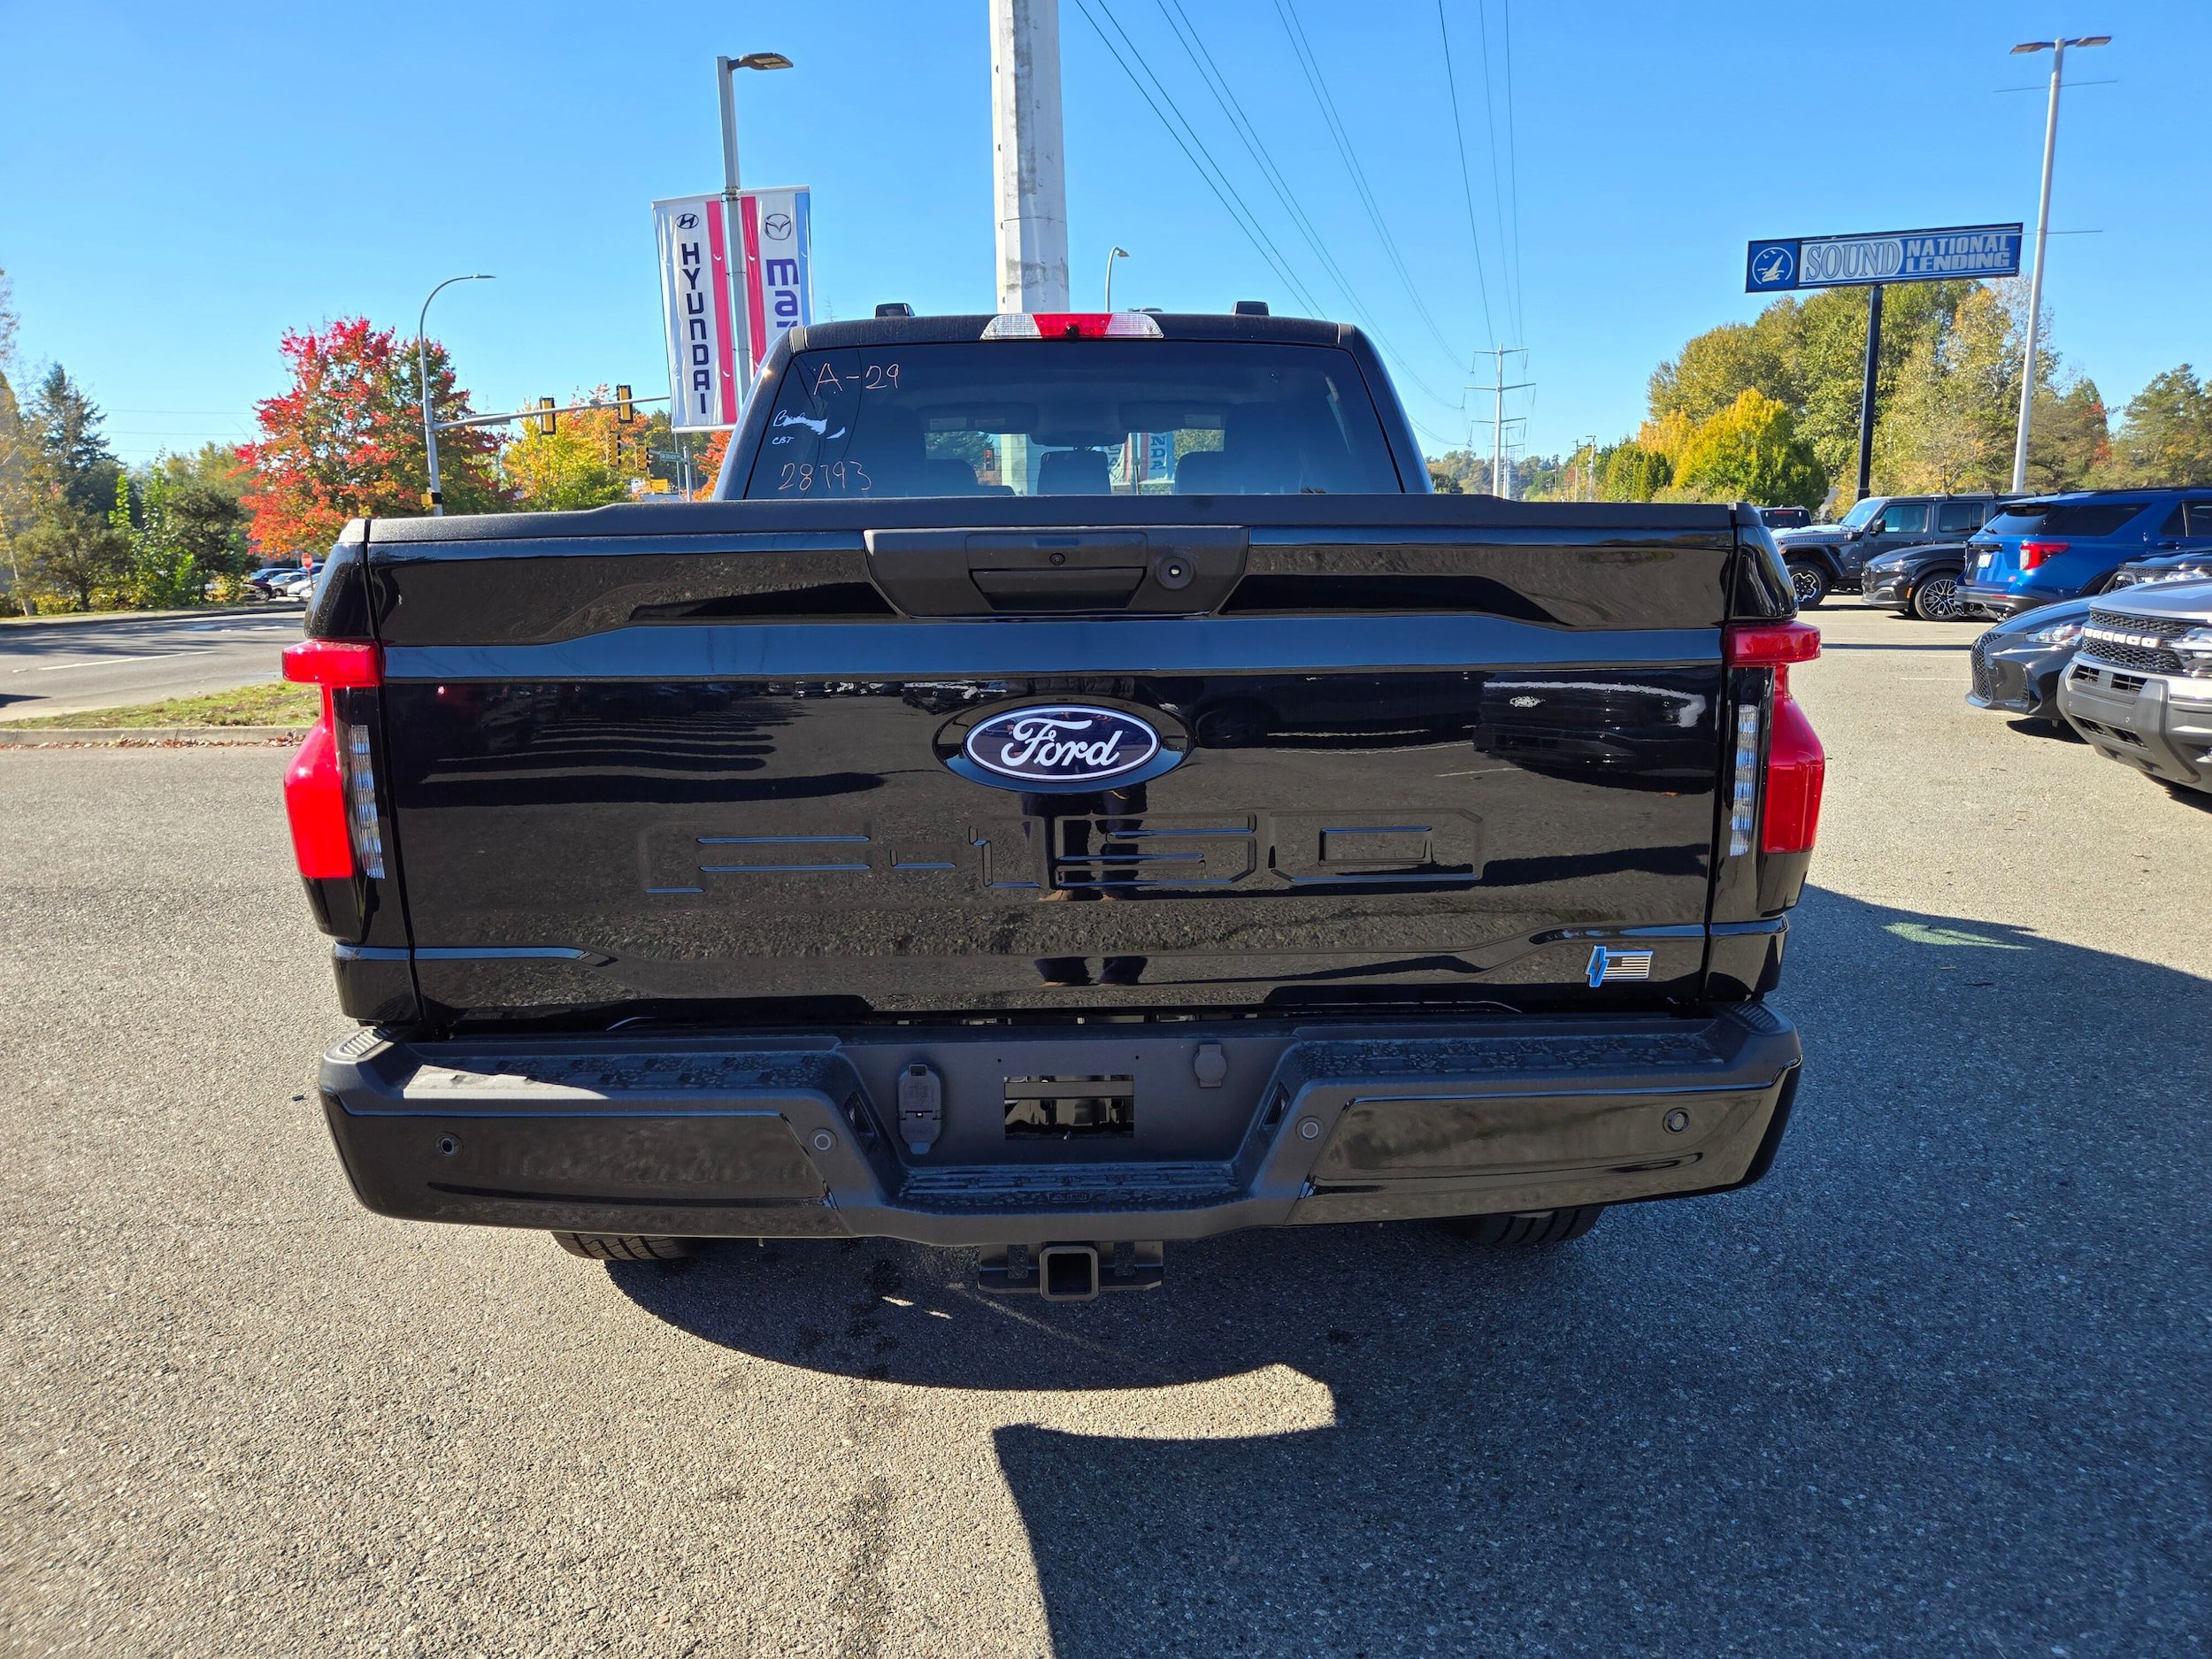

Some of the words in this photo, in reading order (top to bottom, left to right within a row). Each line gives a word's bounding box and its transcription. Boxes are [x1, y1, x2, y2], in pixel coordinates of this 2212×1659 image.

[1805, 239, 1901, 280] SOUND
[1905, 250, 2010, 273] LENDING
[1907, 234, 2010, 257] NATIONAL
[680, 242, 710, 414] HYUNDAI
[814, 363, 900, 395] A-29
[2085, 627, 2161, 649] BRONCO
[1000, 718, 1121, 772] Ford
[642, 809, 1486, 888] F-150
